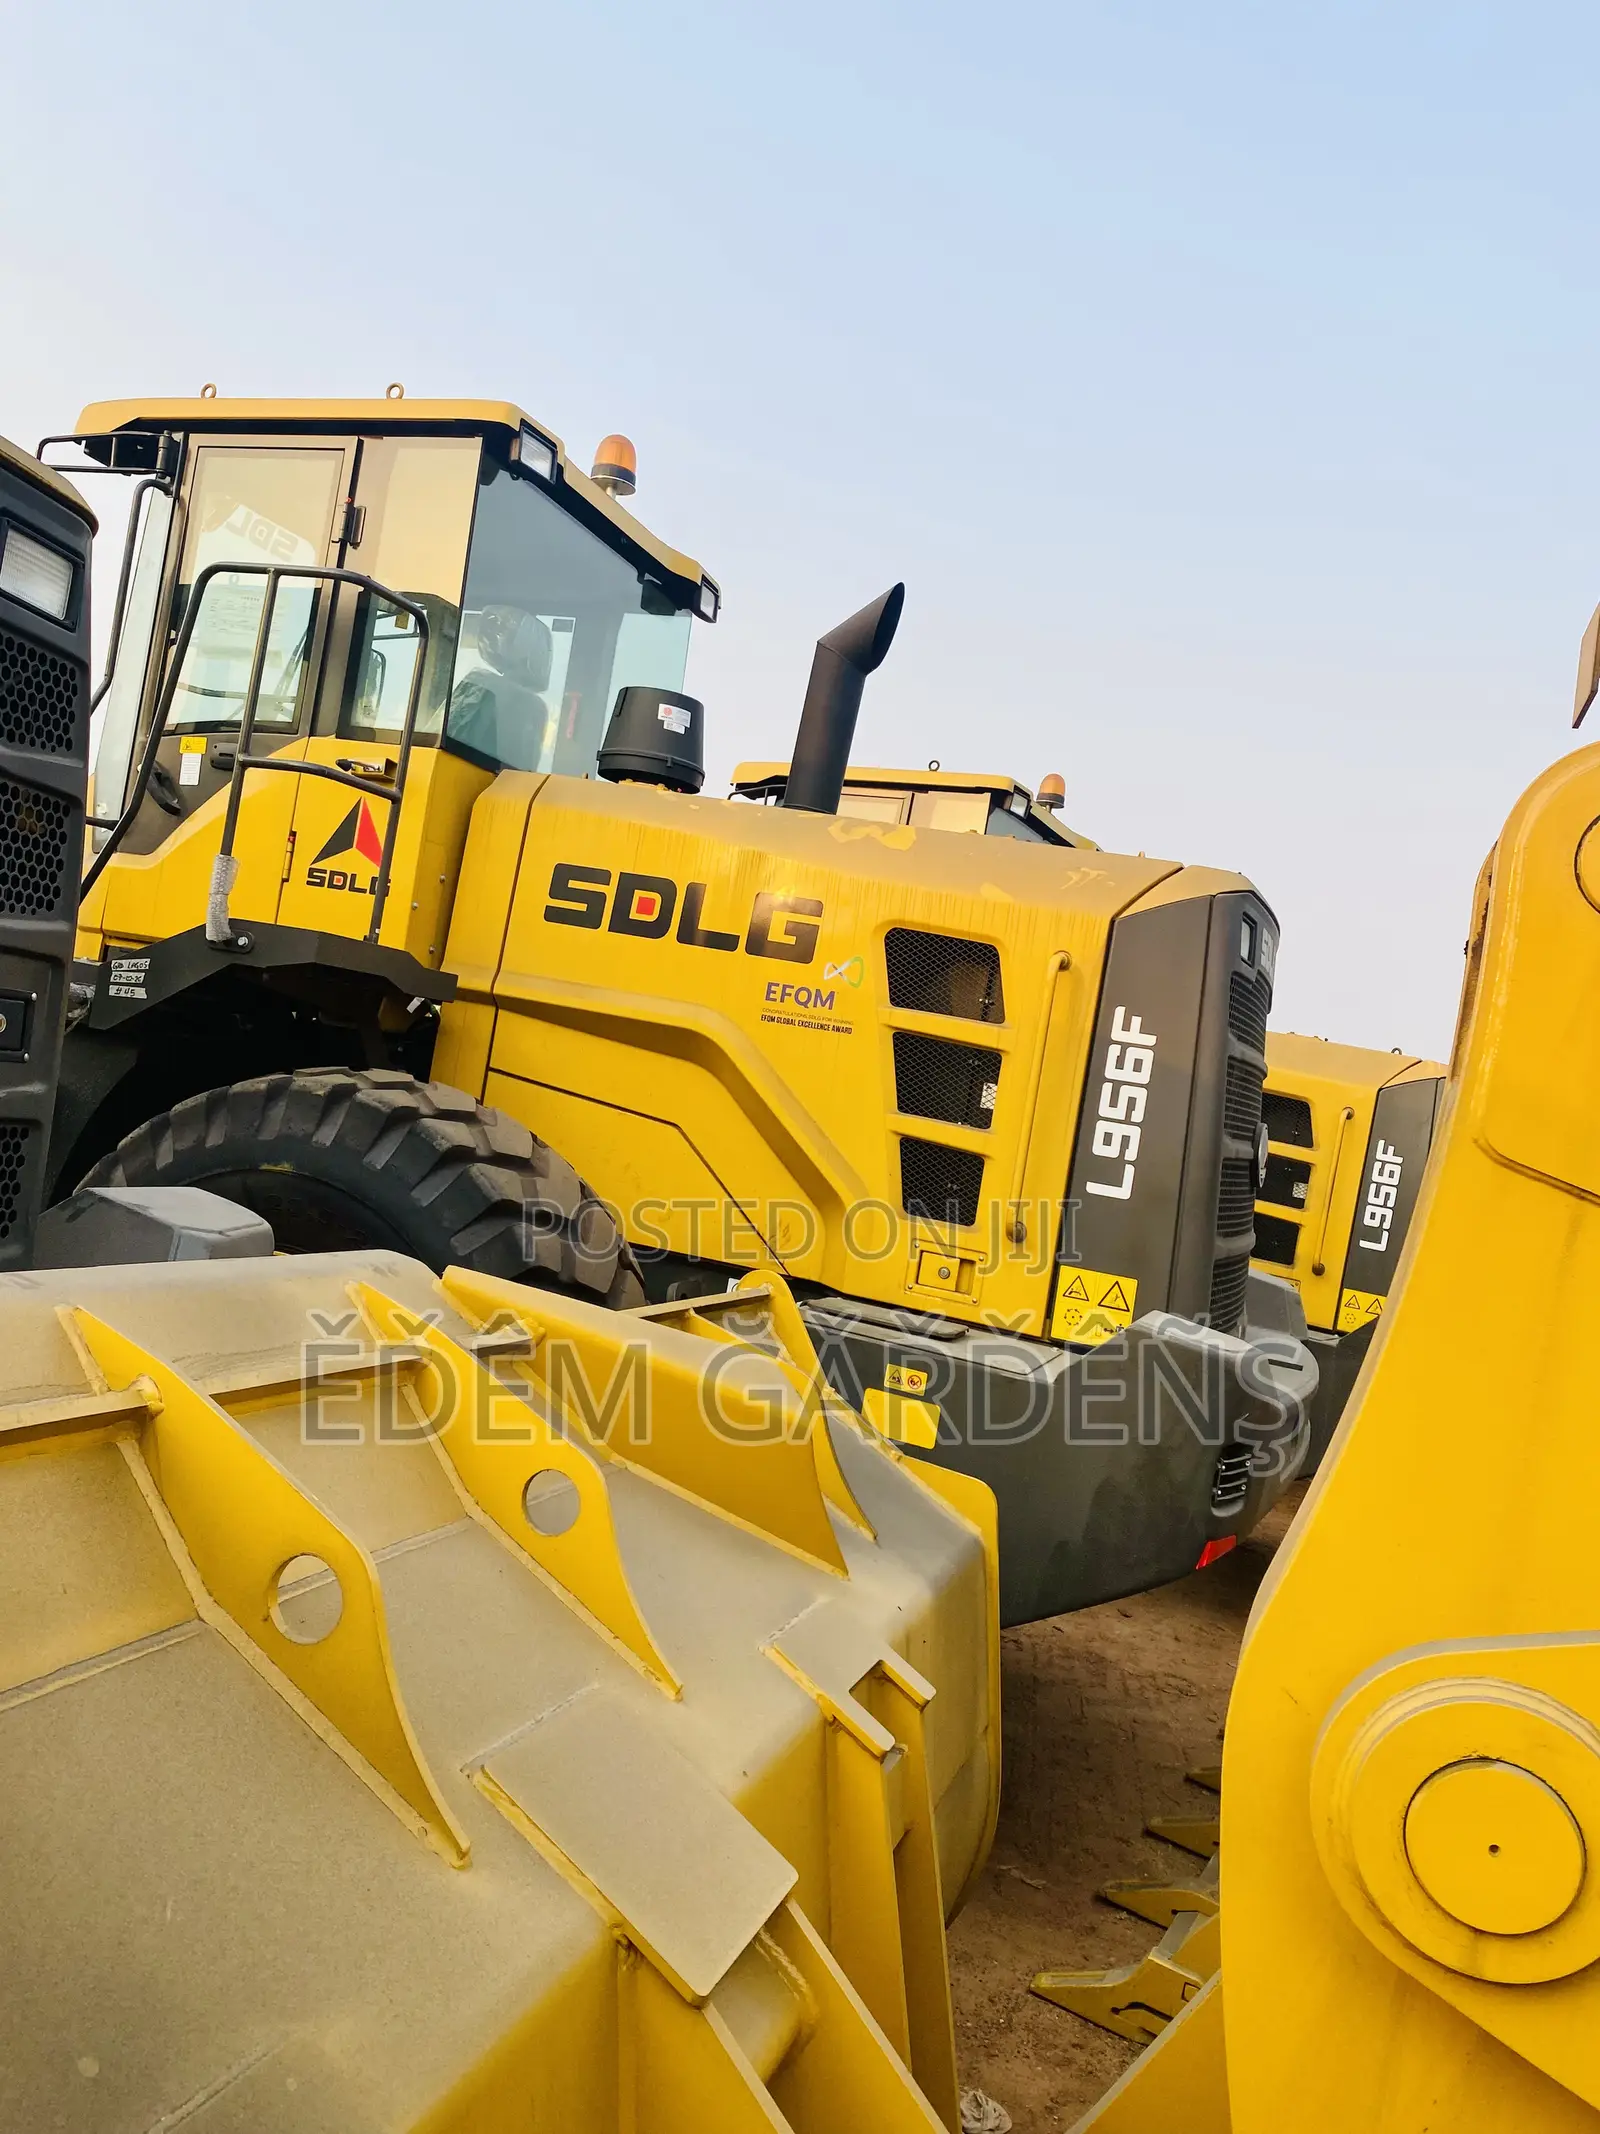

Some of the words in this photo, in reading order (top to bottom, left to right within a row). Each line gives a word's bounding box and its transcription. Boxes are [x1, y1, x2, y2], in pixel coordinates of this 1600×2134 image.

[543, 863, 824, 964] SDLG
[765, 982, 836, 1011] EFQM
[797, 1019, 831, 1032] EXCELLENCE
[831, 1024, 853, 1035] AWARD
[1086, 1005, 1157, 1200] L956F
[1359, 1139, 1404, 1252] L956F
